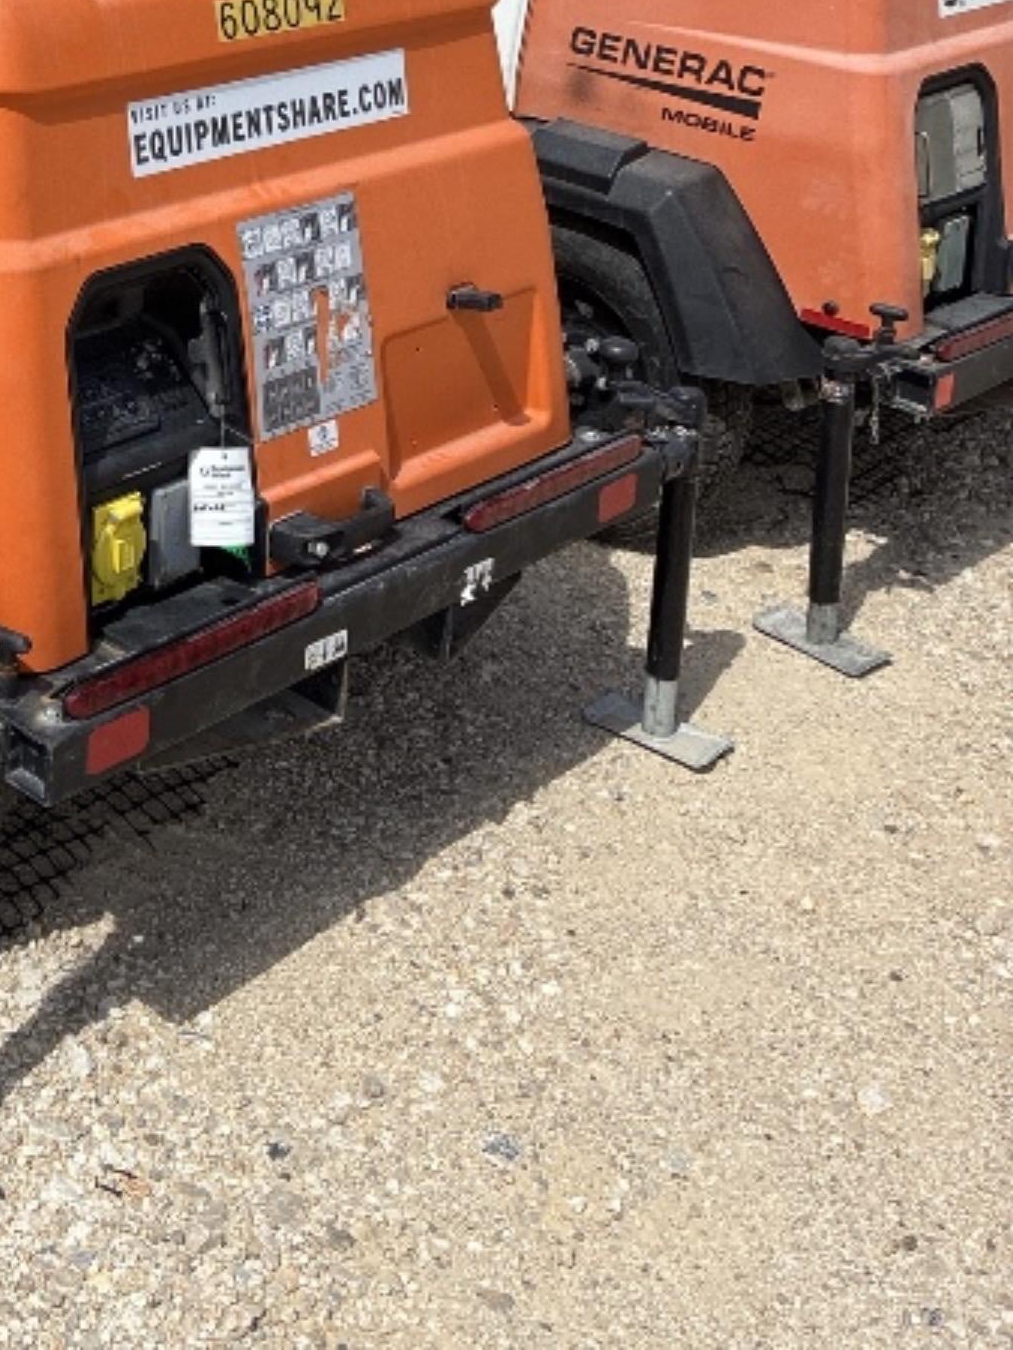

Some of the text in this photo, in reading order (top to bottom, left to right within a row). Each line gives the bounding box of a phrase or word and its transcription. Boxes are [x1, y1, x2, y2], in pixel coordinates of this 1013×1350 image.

[570, 26, 766, 97] GENERAC
[130, 104, 168, 124] VISIT
[173, 98, 191, 115] US
[133, 77, 405, 166] EQUIPMENTSHARE.COM
[661, 107, 756, 141] MOBILE
